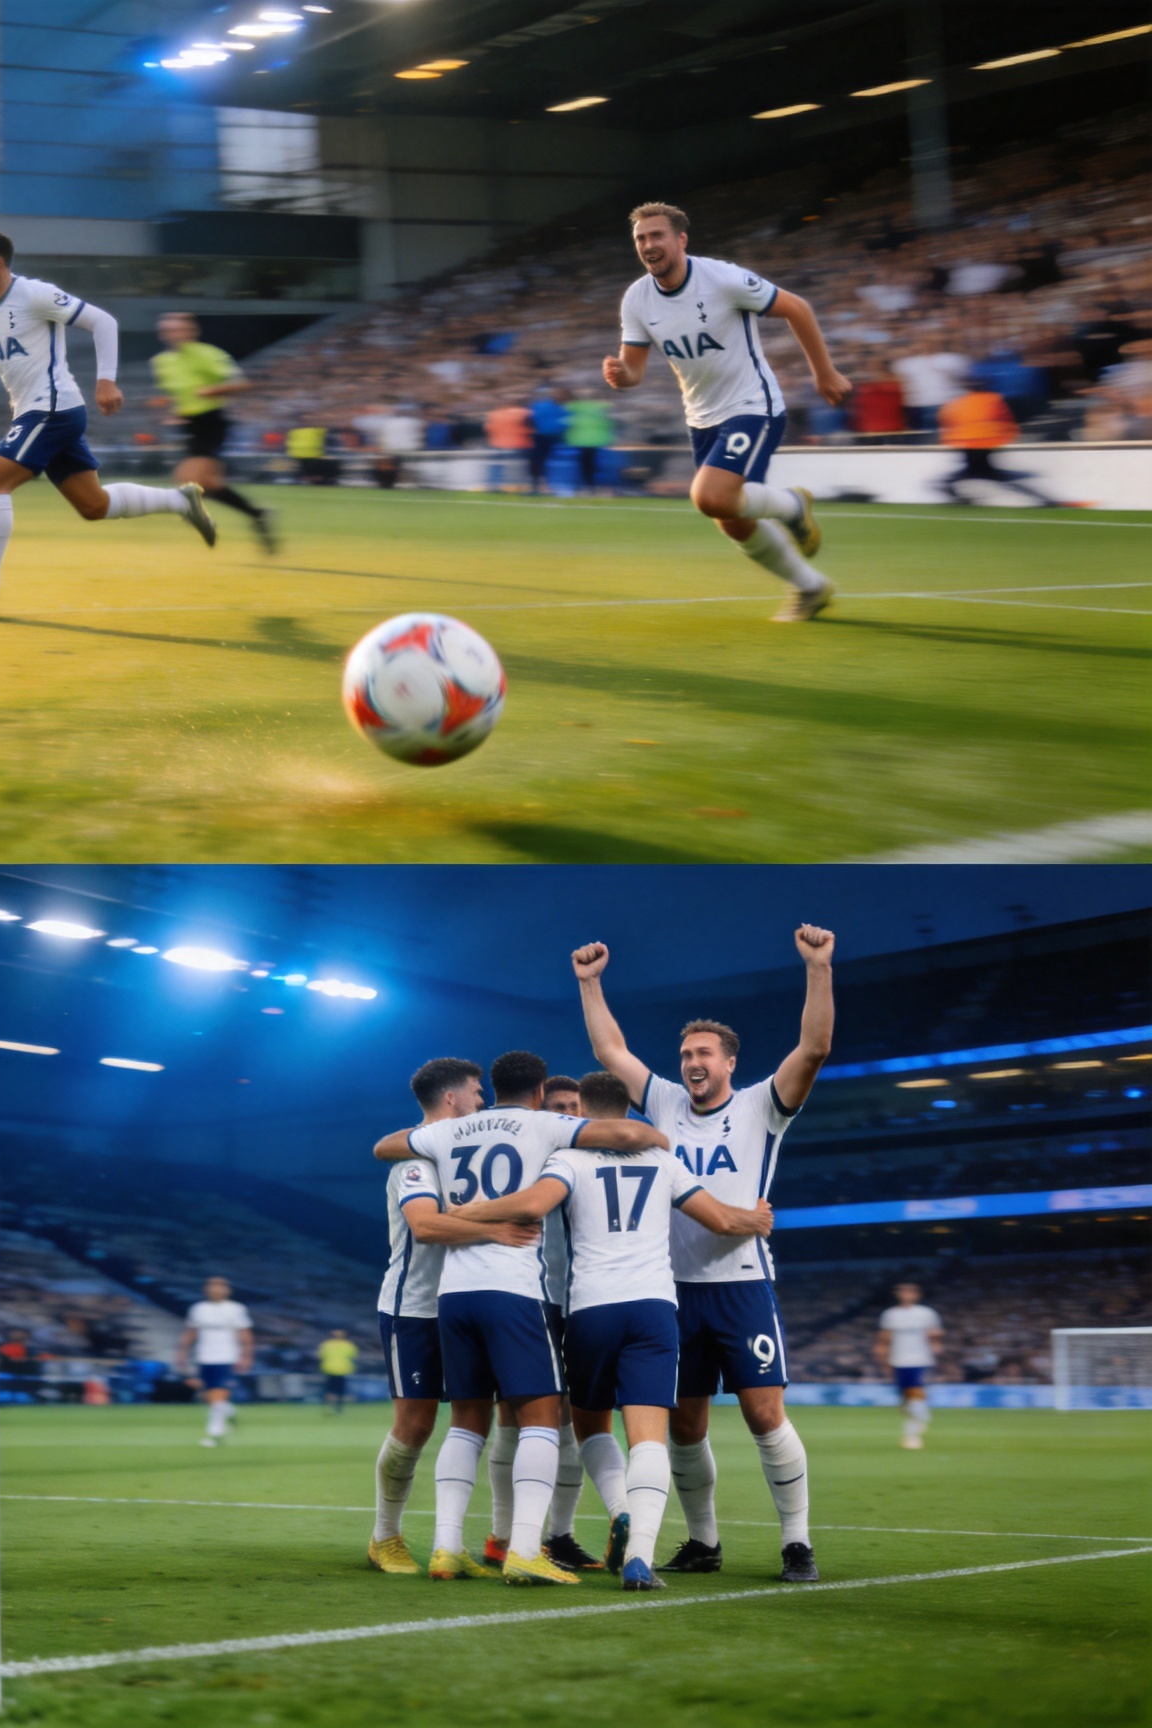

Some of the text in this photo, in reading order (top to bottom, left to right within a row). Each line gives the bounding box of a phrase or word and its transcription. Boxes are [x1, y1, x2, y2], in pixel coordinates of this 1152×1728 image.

[663, 332, 725, 359] AIA
[450, 1143, 523, 1207] 30
[596, 1165, 659, 1233] 17
[753, 1334, 775, 1367] 9
